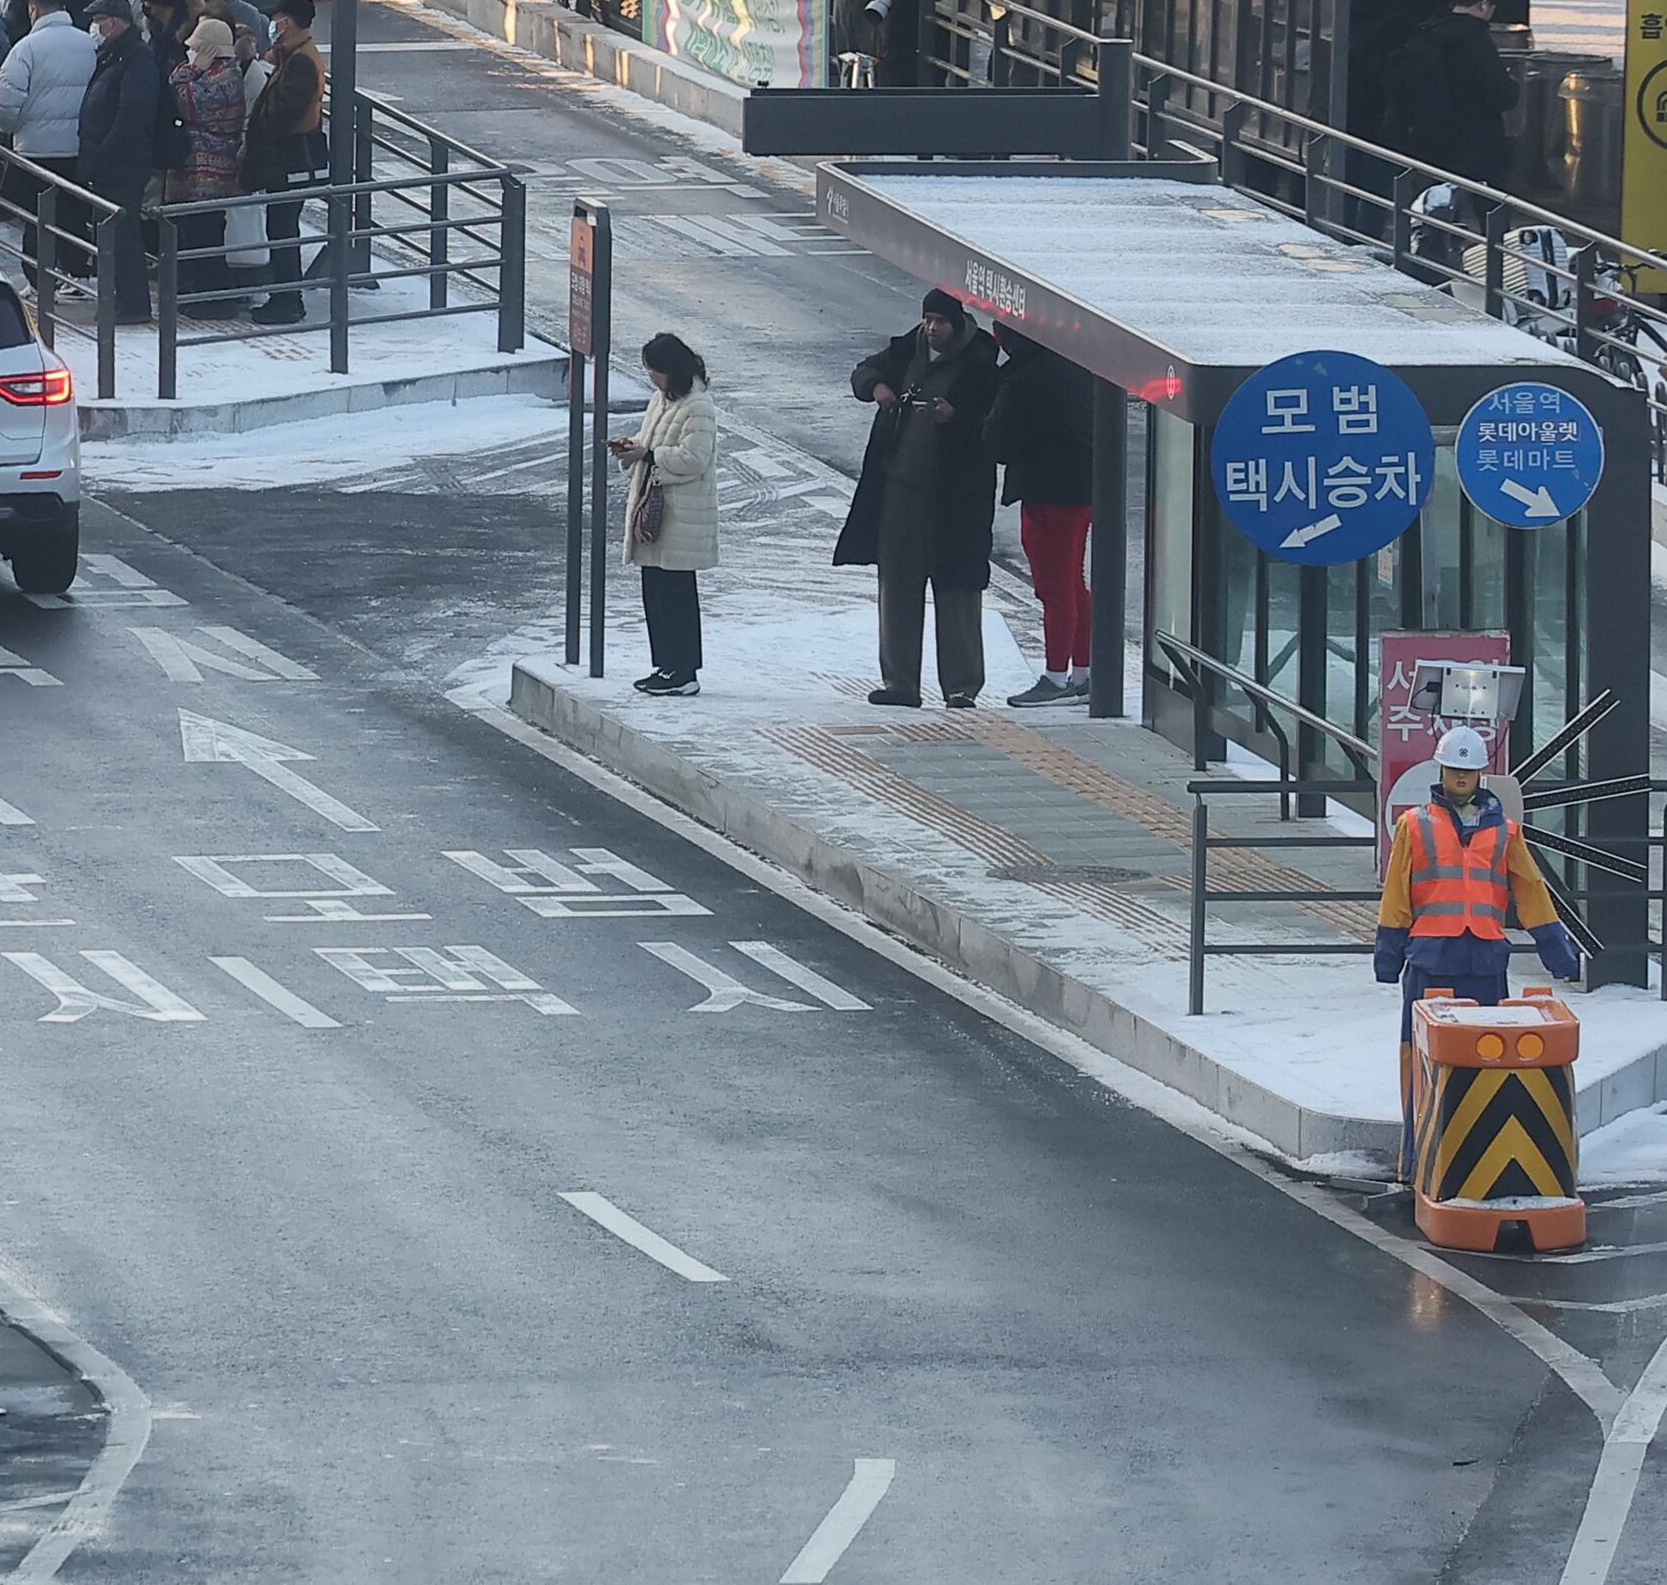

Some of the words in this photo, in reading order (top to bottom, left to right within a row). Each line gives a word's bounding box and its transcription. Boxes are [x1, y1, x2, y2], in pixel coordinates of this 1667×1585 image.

[1488, 392, 1561, 415] 서울역
[1477, 421, 1580, 444] 롯데아울렛
[1476, 448, 1576, 472] 롯데마트
[1225, 451, 1423, 512] 택시승차
